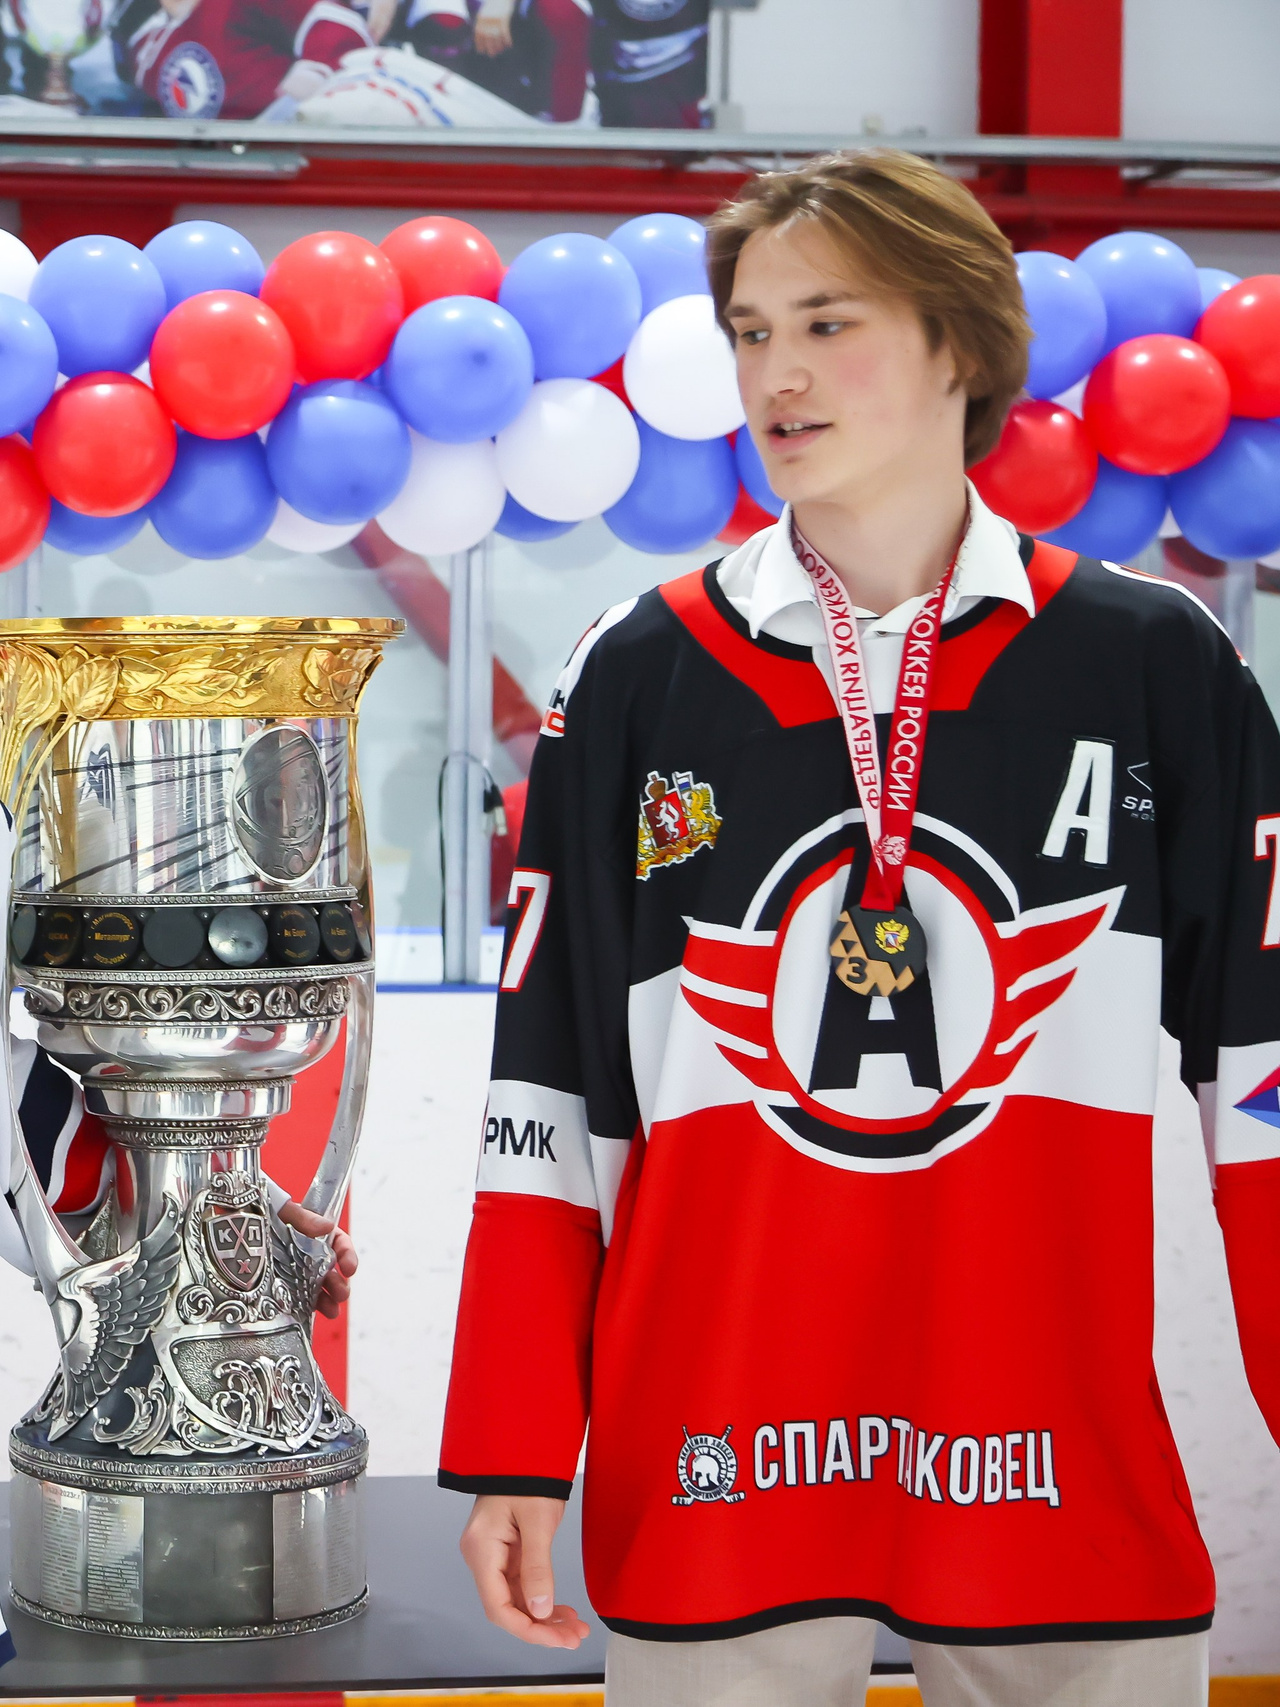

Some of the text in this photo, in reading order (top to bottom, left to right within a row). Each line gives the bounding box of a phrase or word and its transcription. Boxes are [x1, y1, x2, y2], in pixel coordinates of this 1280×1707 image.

[886, 602, 938, 811] ХОККЕЯ РОССИИ
[499, 866, 553, 992] 7
[846, 957, 867, 984] 3
[484, 1116, 557, 1163] РМК
[754, 1416, 1060, 1507] СПАРТАКОВЕЦ
